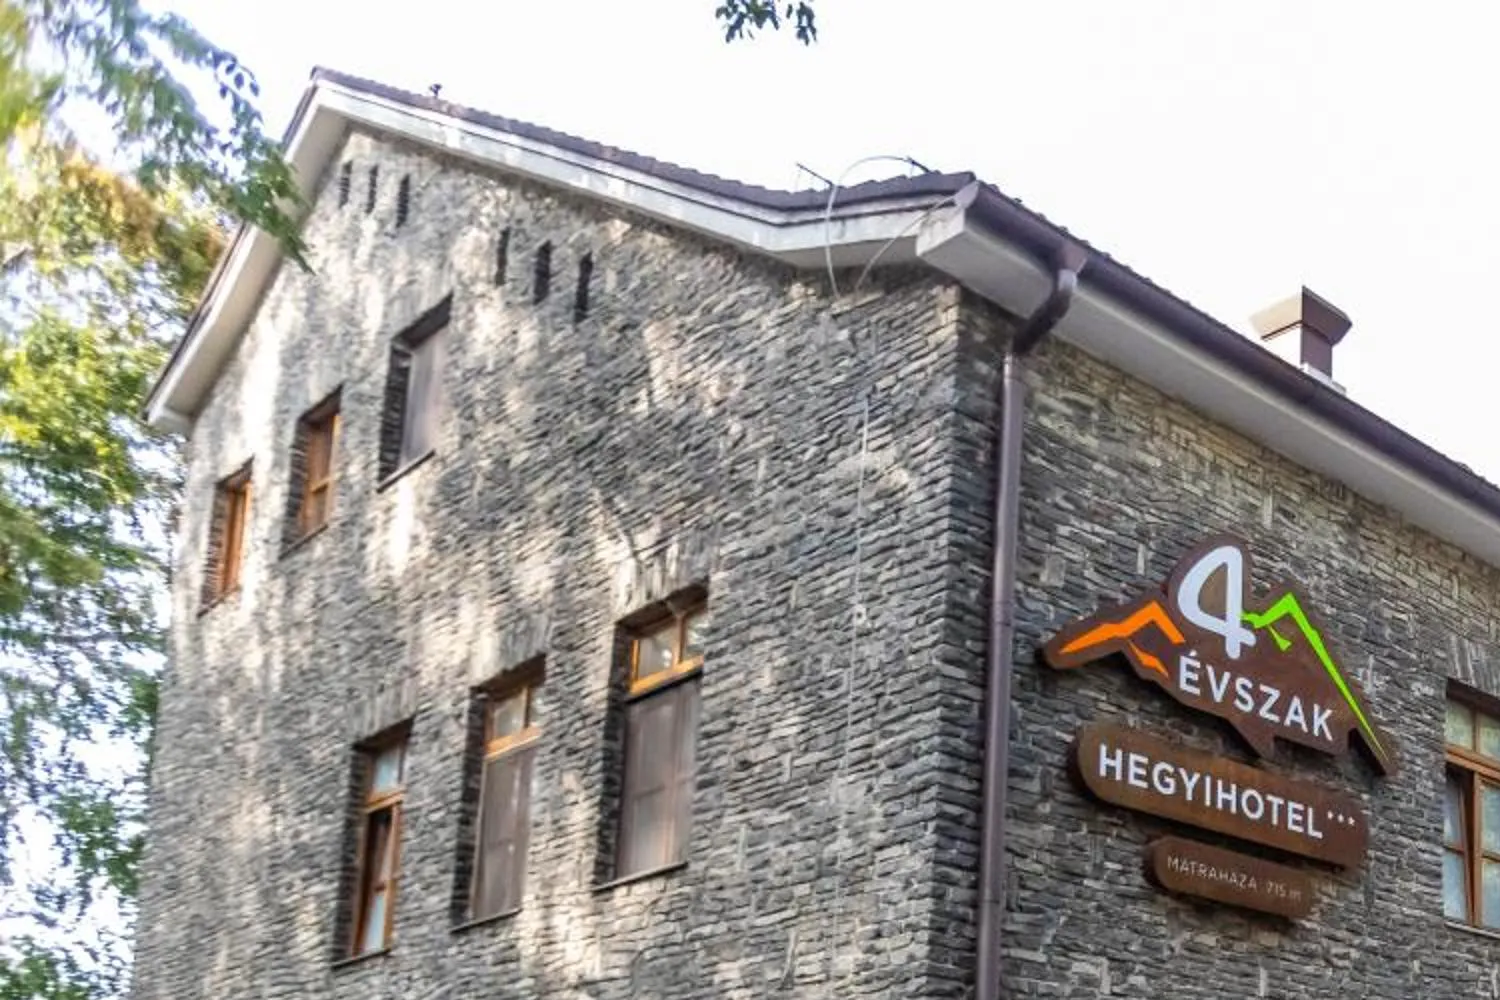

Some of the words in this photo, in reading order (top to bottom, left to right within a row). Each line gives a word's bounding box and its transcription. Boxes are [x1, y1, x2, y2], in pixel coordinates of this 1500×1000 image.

[1178, 546, 1257, 659] 4
[1178, 650, 1333, 741] ÉVSZAK
[1099, 744, 1322, 839] HEGYIHOTEL
